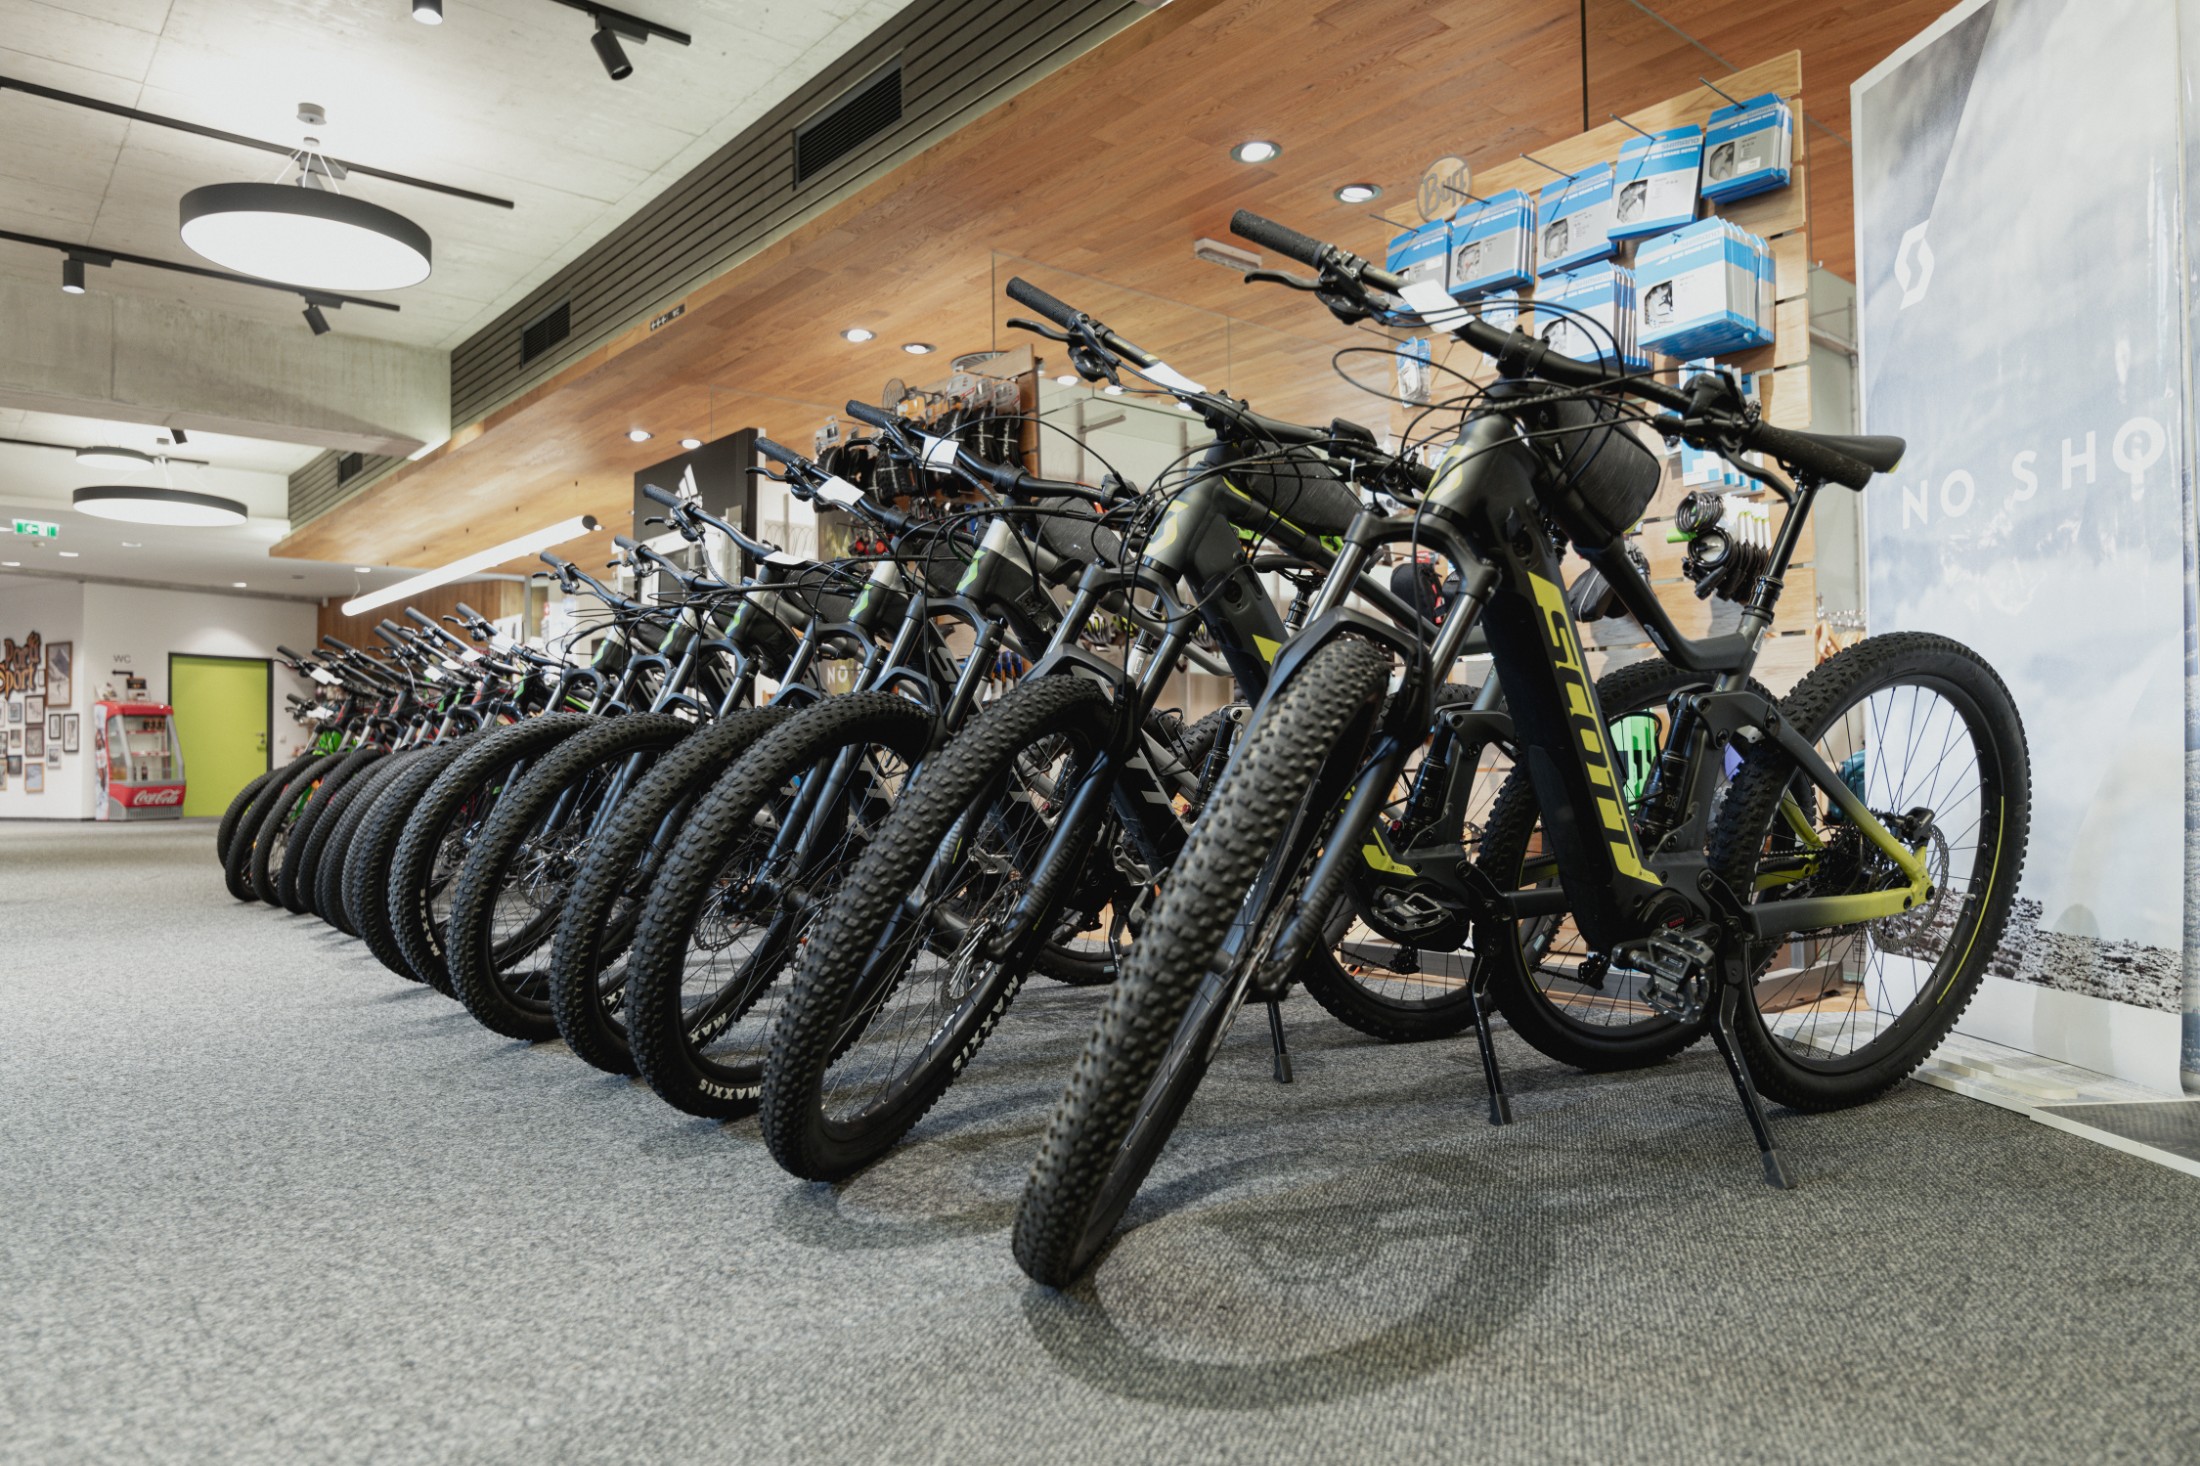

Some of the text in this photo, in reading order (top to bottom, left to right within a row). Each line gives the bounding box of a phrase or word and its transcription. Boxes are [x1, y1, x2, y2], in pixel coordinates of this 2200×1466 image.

[1902, 469, 1975, 530] NO
[112, 654, 132, 664] WC
[1538, 598, 1640, 872] SCOTT
[688, 1012, 727, 1044] MAX
[952, 975, 1019, 1071] MAXXIS
[699, 1078, 761, 1100] MAXXIS
